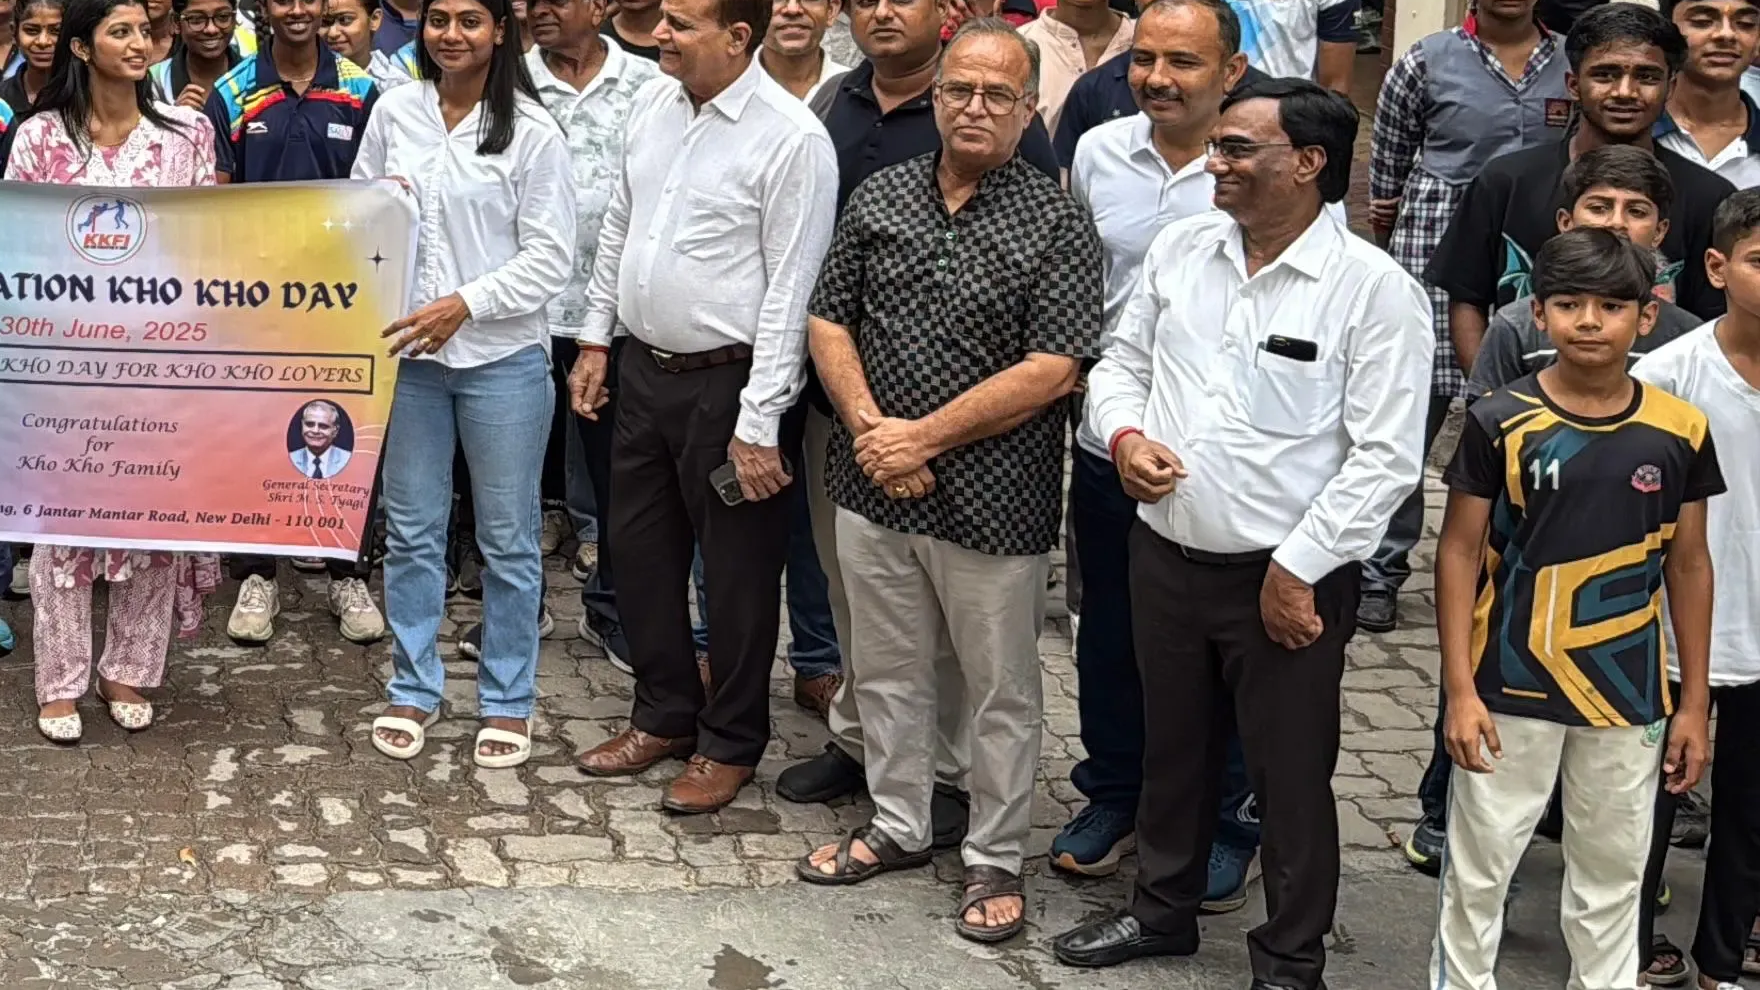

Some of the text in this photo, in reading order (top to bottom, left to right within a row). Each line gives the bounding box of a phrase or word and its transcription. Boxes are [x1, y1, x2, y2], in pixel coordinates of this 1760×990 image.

[83, 234, 131, 247] KKFI
[107, 275, 183, 306] KHO
[193, 278, 270, 308] KHO
[280, 281, 358, 313] DAY
[0, 316, 208, 343] 30th June, 2025
[0, 356, 51, 375] KHO
[56, 360, 108, 379] DAY
[112, 362, 158, 379] FOR
[164, 363, 216, 380] KHO
[220, 363, 273, 382] KHO
[278, 365, 364, 383] LOVERS
[22, 413, 179, 434] Congratulations
[80, 435, 115, 457] for
[15, 454, 181, 481] Kho Kho Family
[1528, 458, 1560, 490] 11
[262, 479, 370, 499] General Secretary
[267, 492, 293, 503] Shri
[331, 494, 365, 510] Tyagi
[23, 504, 32, 515] 6
[36, 505, 85, 518] Jantar
[89, 507, 144, 521] Mantar
[148, 510, 190, 524] Road,
[195, 511, 227, 524] New
[231, 512, 271, 526] Delhi
[285, 514, 313, 527] 110
[318, 516, 345, 530] 001
